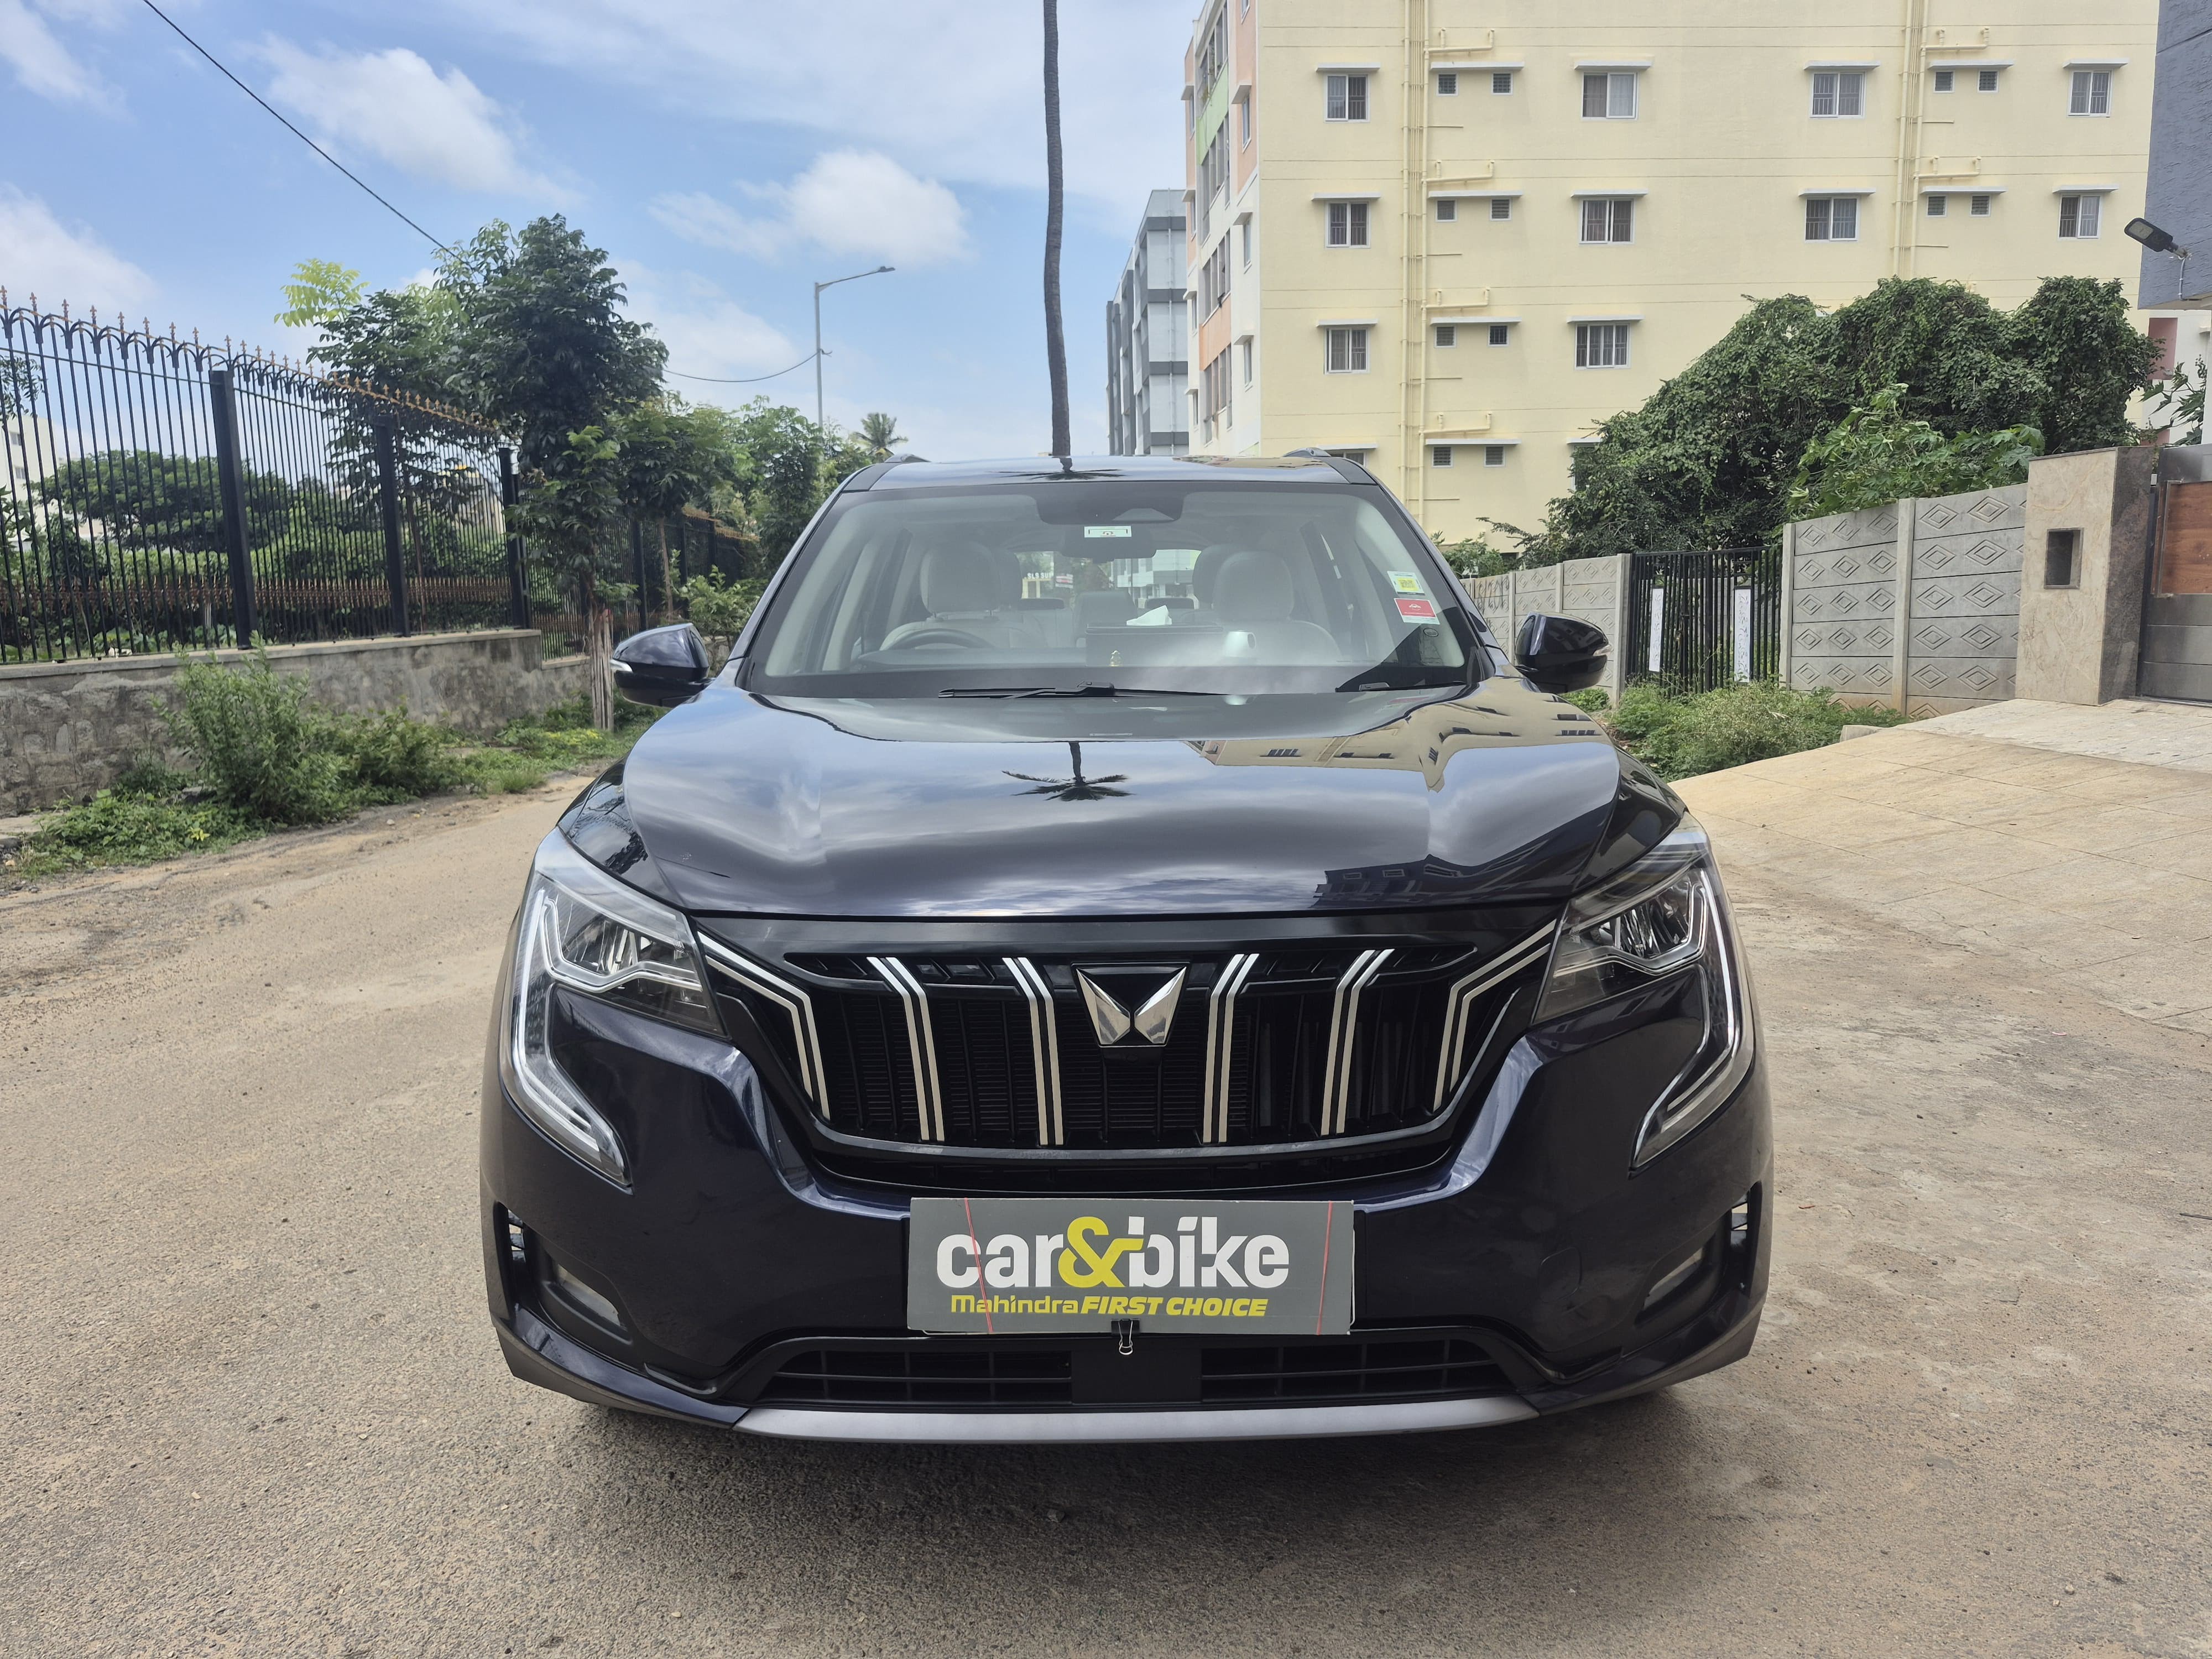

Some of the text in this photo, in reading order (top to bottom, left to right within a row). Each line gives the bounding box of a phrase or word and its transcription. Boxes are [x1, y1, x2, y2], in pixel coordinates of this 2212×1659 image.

[936, 1216, 1290, 1288] car&bike
[951, 1295, 1269, 1317] Mahindra FIRST CHOICE
